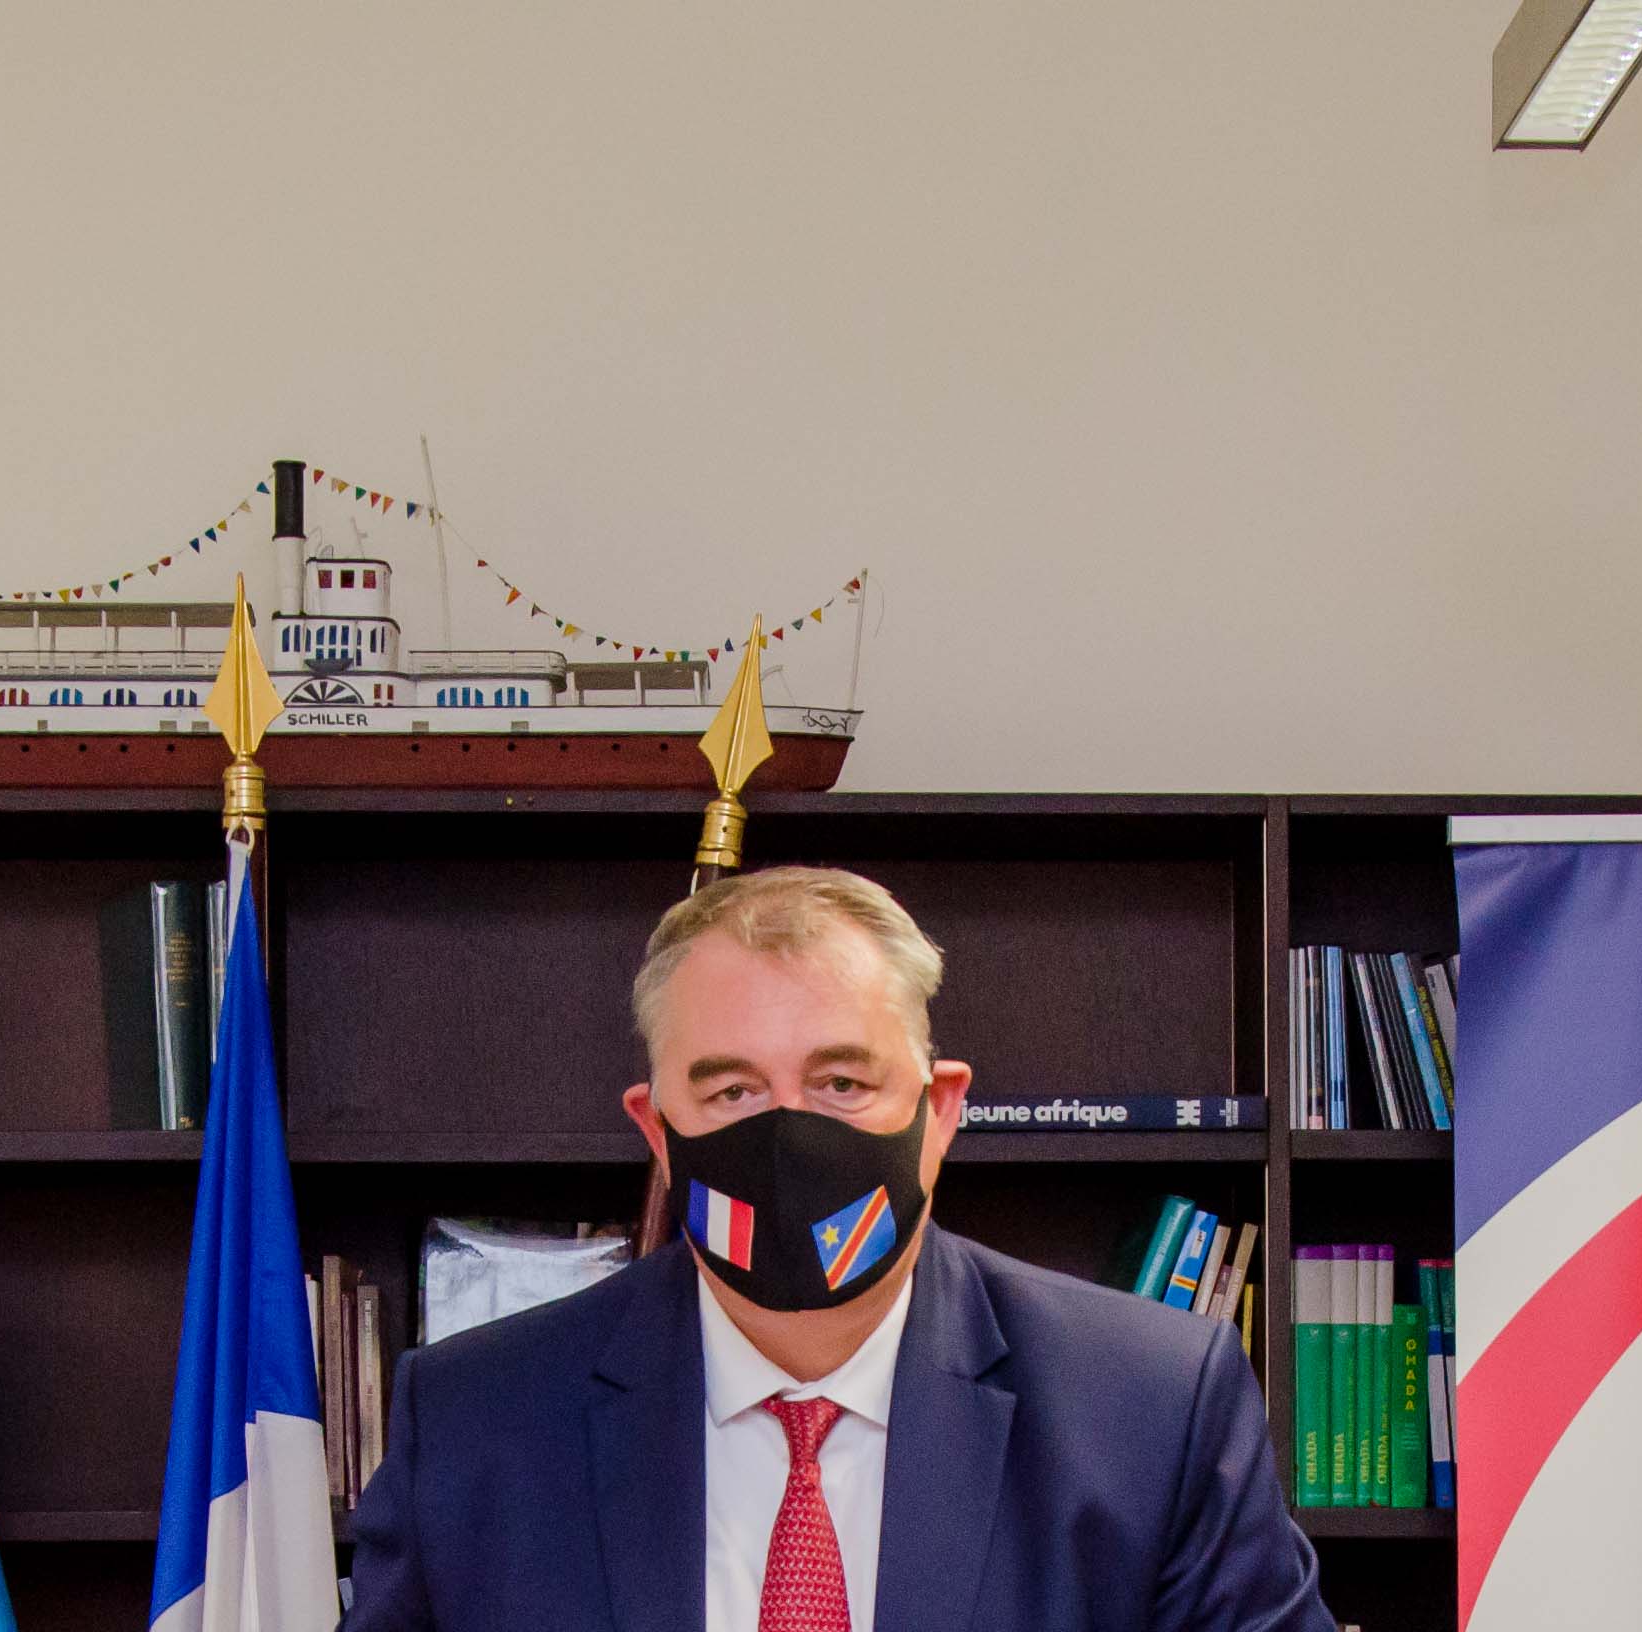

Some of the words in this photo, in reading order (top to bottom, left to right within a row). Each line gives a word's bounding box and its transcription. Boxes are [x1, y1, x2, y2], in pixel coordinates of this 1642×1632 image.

[287, 713, 368, 726] SCHILLER
[960, 1099, 1031, 1127] jeune
[1034, 1099, 1128, 1127] afrique
[1405, 1339, 1417, 1410] OHADA
